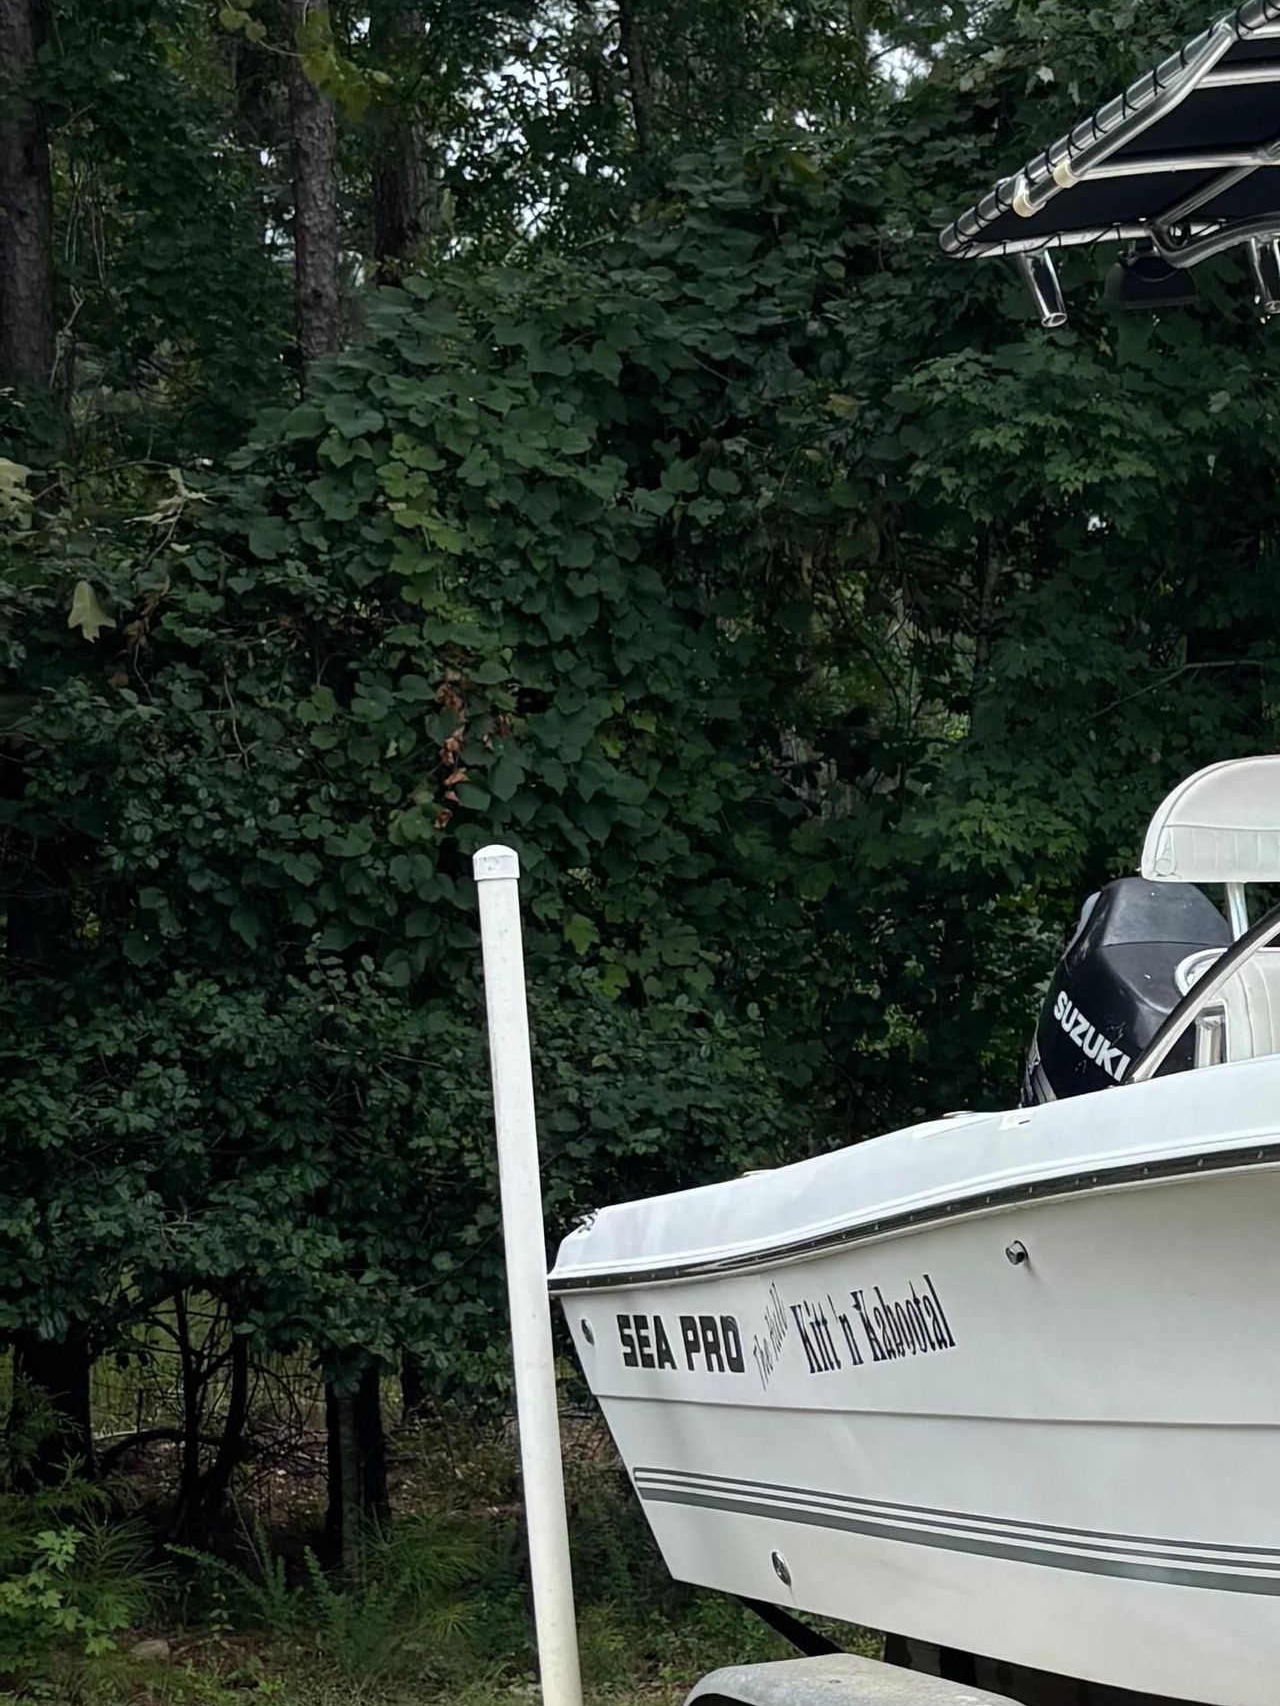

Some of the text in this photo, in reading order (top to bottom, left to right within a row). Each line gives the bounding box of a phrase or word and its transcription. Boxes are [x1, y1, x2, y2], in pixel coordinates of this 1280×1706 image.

[1054, 990, 1131, 1082] SUZUKI
[616, 1314, 746, 1374] SEA PRO
[790, 1300, 842, 1374] Kitt
